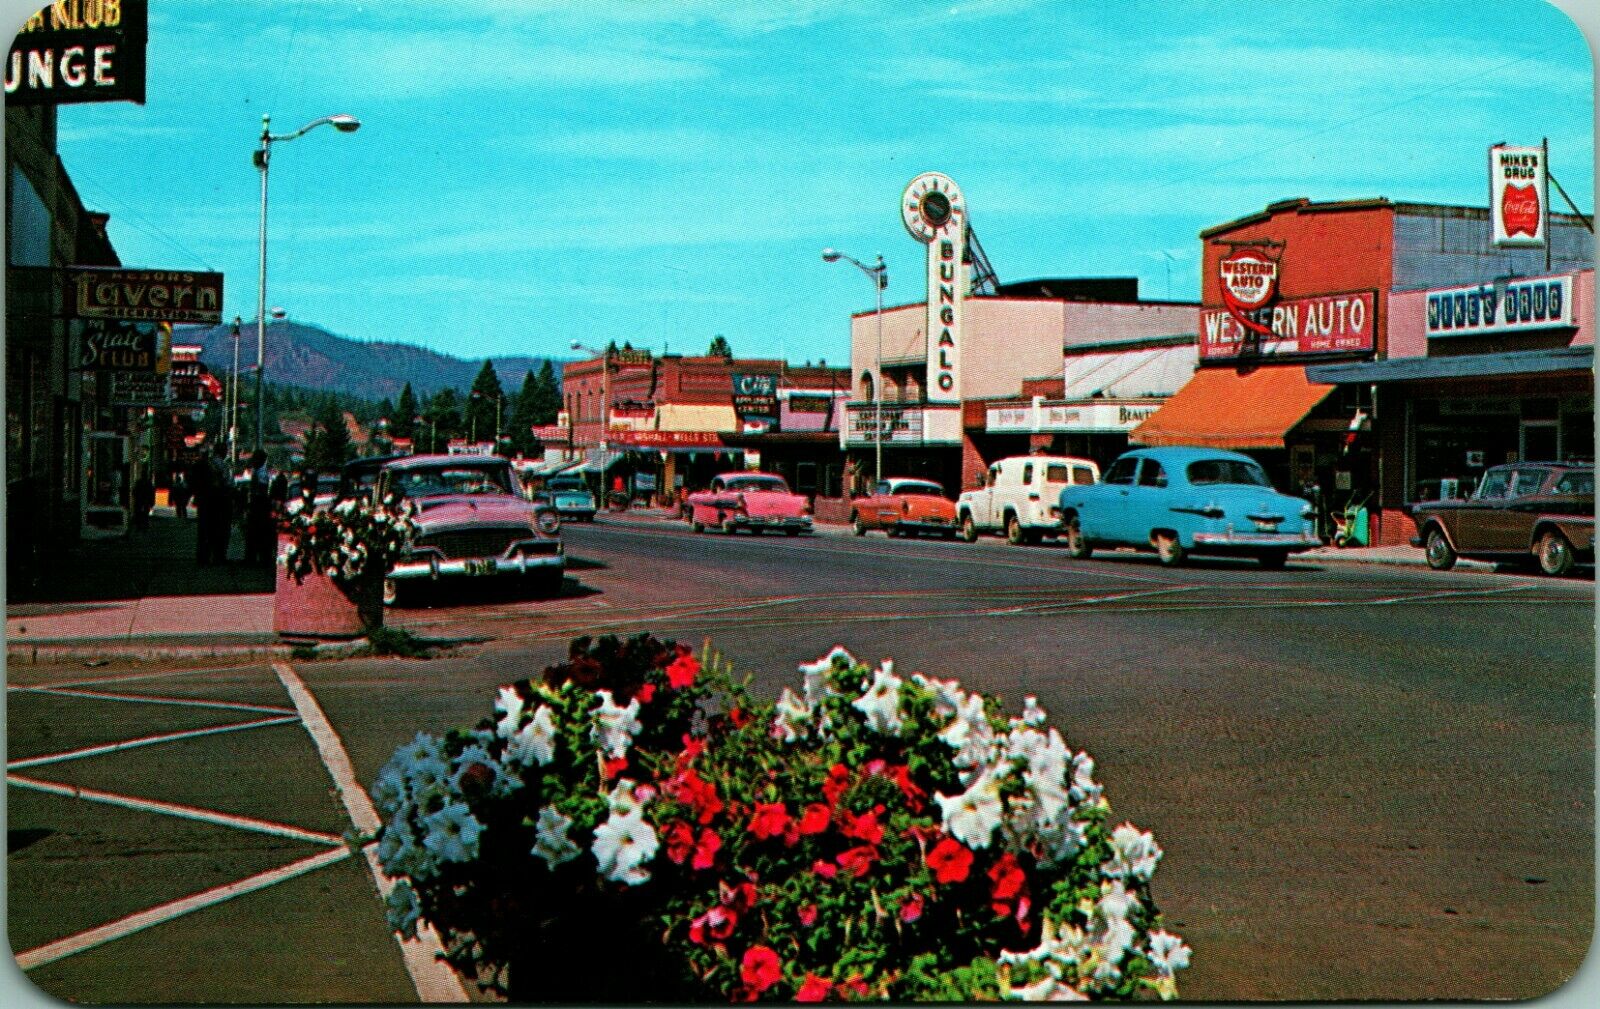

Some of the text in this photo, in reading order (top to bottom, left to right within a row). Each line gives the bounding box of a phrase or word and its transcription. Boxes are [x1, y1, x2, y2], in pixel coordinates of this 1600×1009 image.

[1500, 153, 1538, 167] MIKE'S
[1504, 167, 1535, 179] DRUG
[1223, 263, 1274, 277] WESTERN
[1231, 276, 1264, 288] AUTO
[1505, 285, 1561, 319] DRUG
[939, 241, 954, 392] BUNGALO
[1304, 298, 1365, 337] AUTO
[1120, 406, 1153, 424] BEAUT
